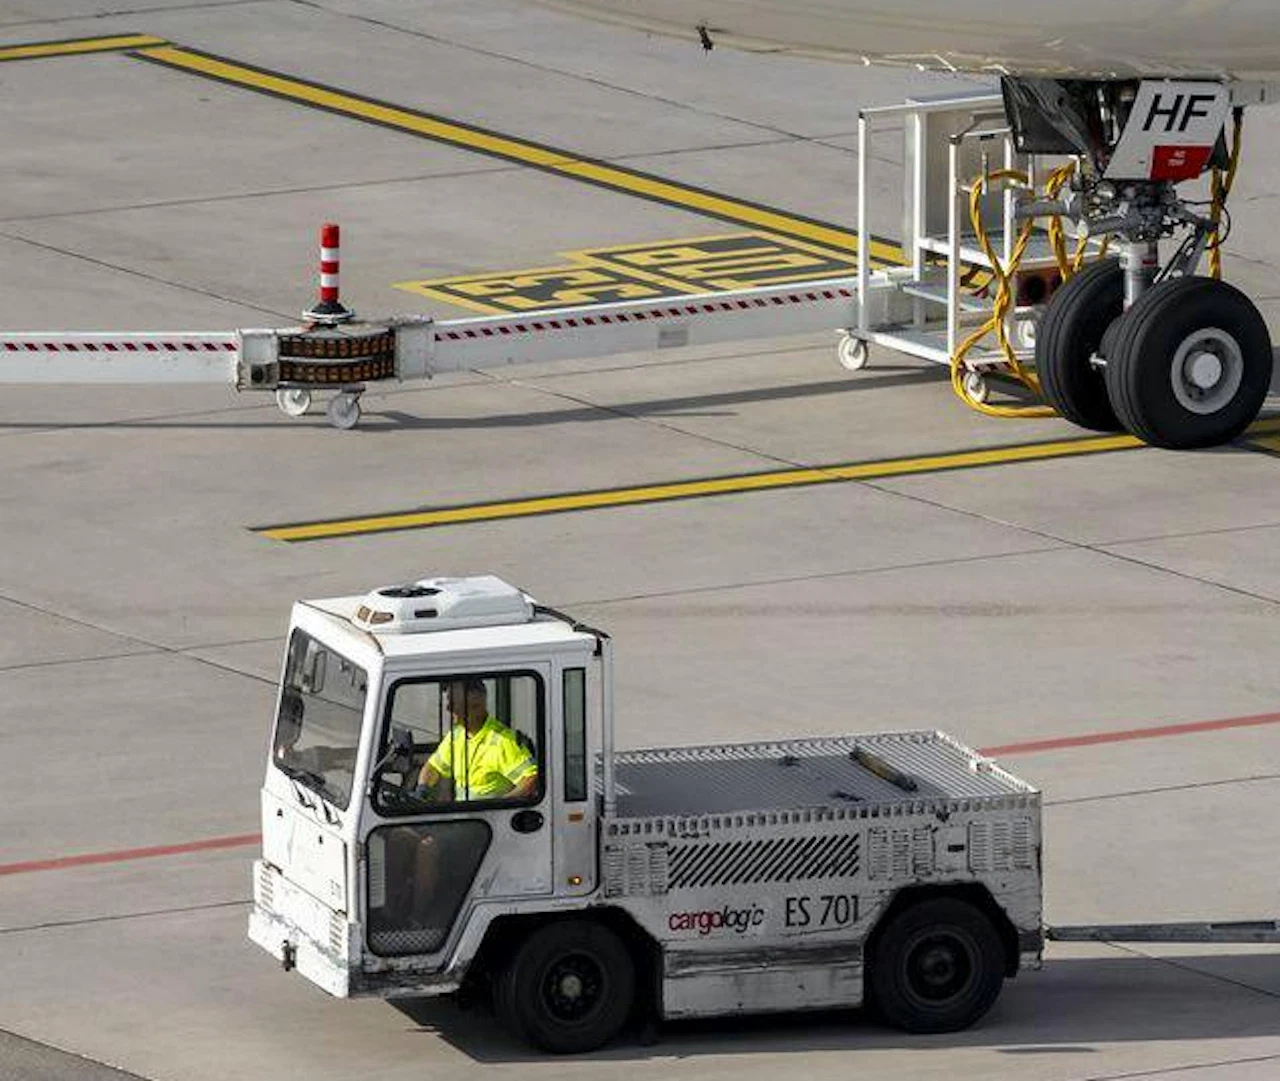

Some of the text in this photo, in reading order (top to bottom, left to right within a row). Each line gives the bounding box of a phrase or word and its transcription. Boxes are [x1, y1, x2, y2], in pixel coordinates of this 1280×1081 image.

[1142, 94, 1216, 131] HF
[668, 895, 859, 935] cargologic ES 701
